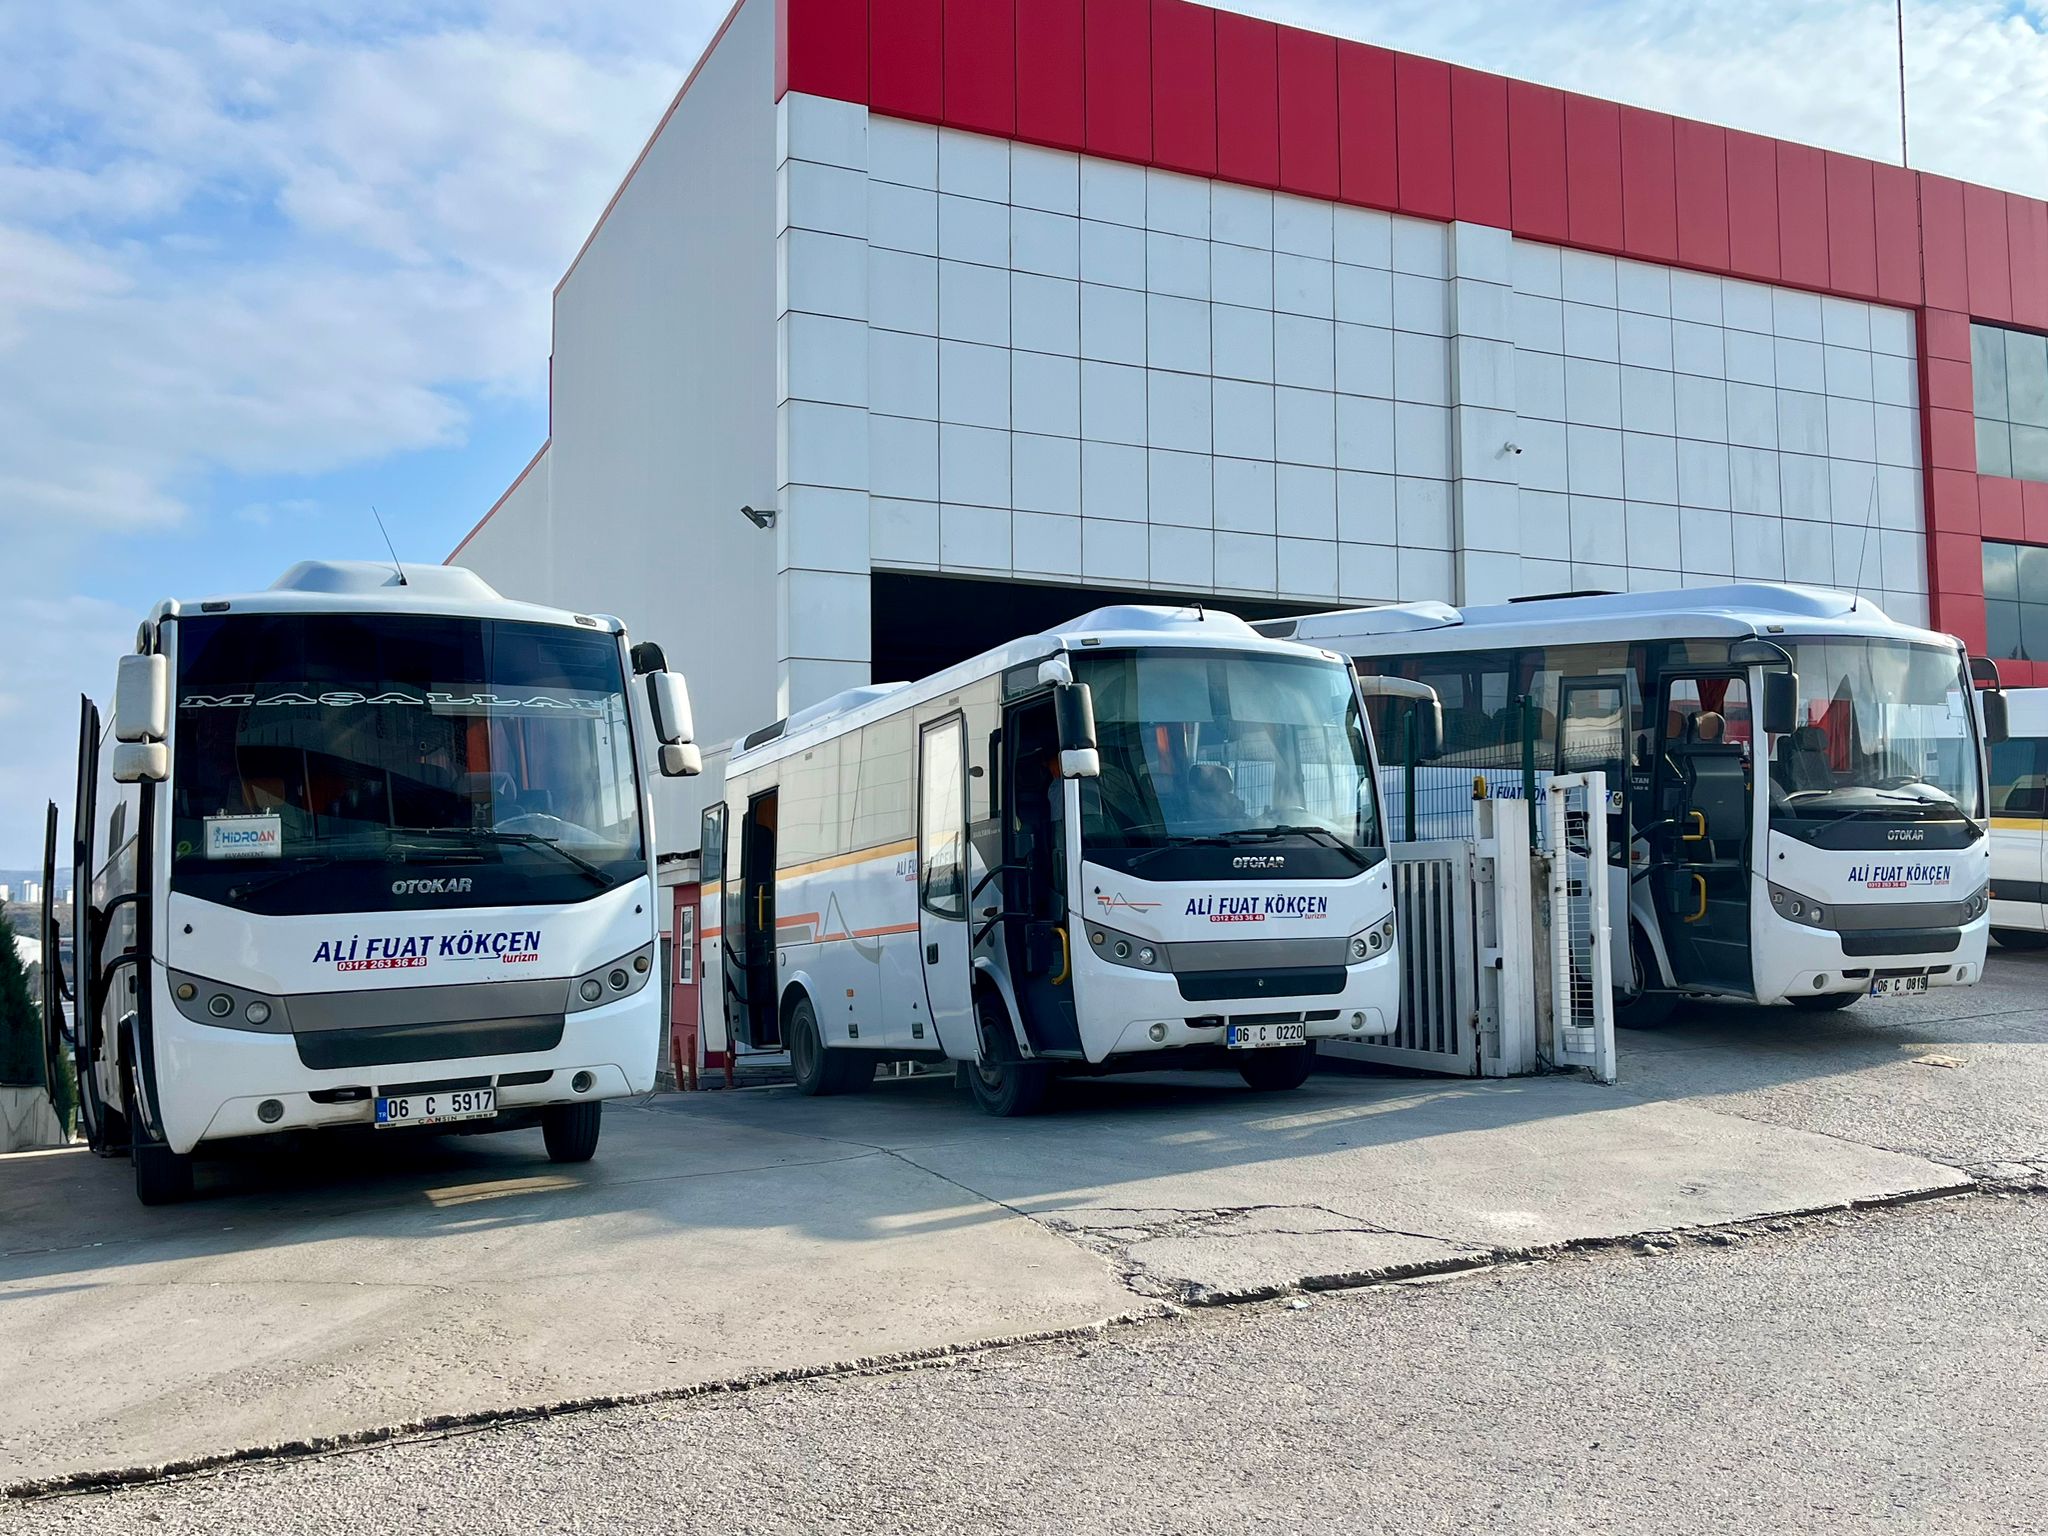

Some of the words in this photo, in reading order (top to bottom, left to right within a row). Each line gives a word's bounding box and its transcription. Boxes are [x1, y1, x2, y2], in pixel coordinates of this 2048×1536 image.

[1496, 786, 1523, 799] FUAT
[1887, 829, 1924, 841] OTOKAR
[896, 858, 907, 876] ALİ
[1232, 856, 1285, 868] OTOKAR
[1848, 864, 1869, 882] ALİ
[1873, 866, 1903, 881] FUAT
[1906, 863, 1951, 883] KÖKÇEN
[392, 878, 473, 895] OTOKAR
[1185, 894, 1213, 915] ALİ
[1219, 897, 1259, 914] FUAT
[1265, 894, 1328, 916] KÖKÇEN
[312, 934, 359, 963] ALİ
[366, 936, 435, 959] FUAT
[439, 930, 541, 958] KÖKÇEN
[338, 962, 367, 971] 0312
[370, 960, 392, 969] 263
[395, 959, 409, 968] 36
[411, 958, 425, 967] 48
[502, 952, 539, 964] turizm
[1877, 980, 1888, 992] 06
[1894, 979, 1900, 991] C
[1906, 977, 1926, 990] 0819
[1236, 1028, 1249, 1042] 06
[1260, 1027, 1266, 1041] C
[1276, 1025, 1303, 1040] 0220
[388, 1099, 409, 1118] 06
[426, 1097, 436, 1115] C
[452, 1091, 492, 1112] 5917
